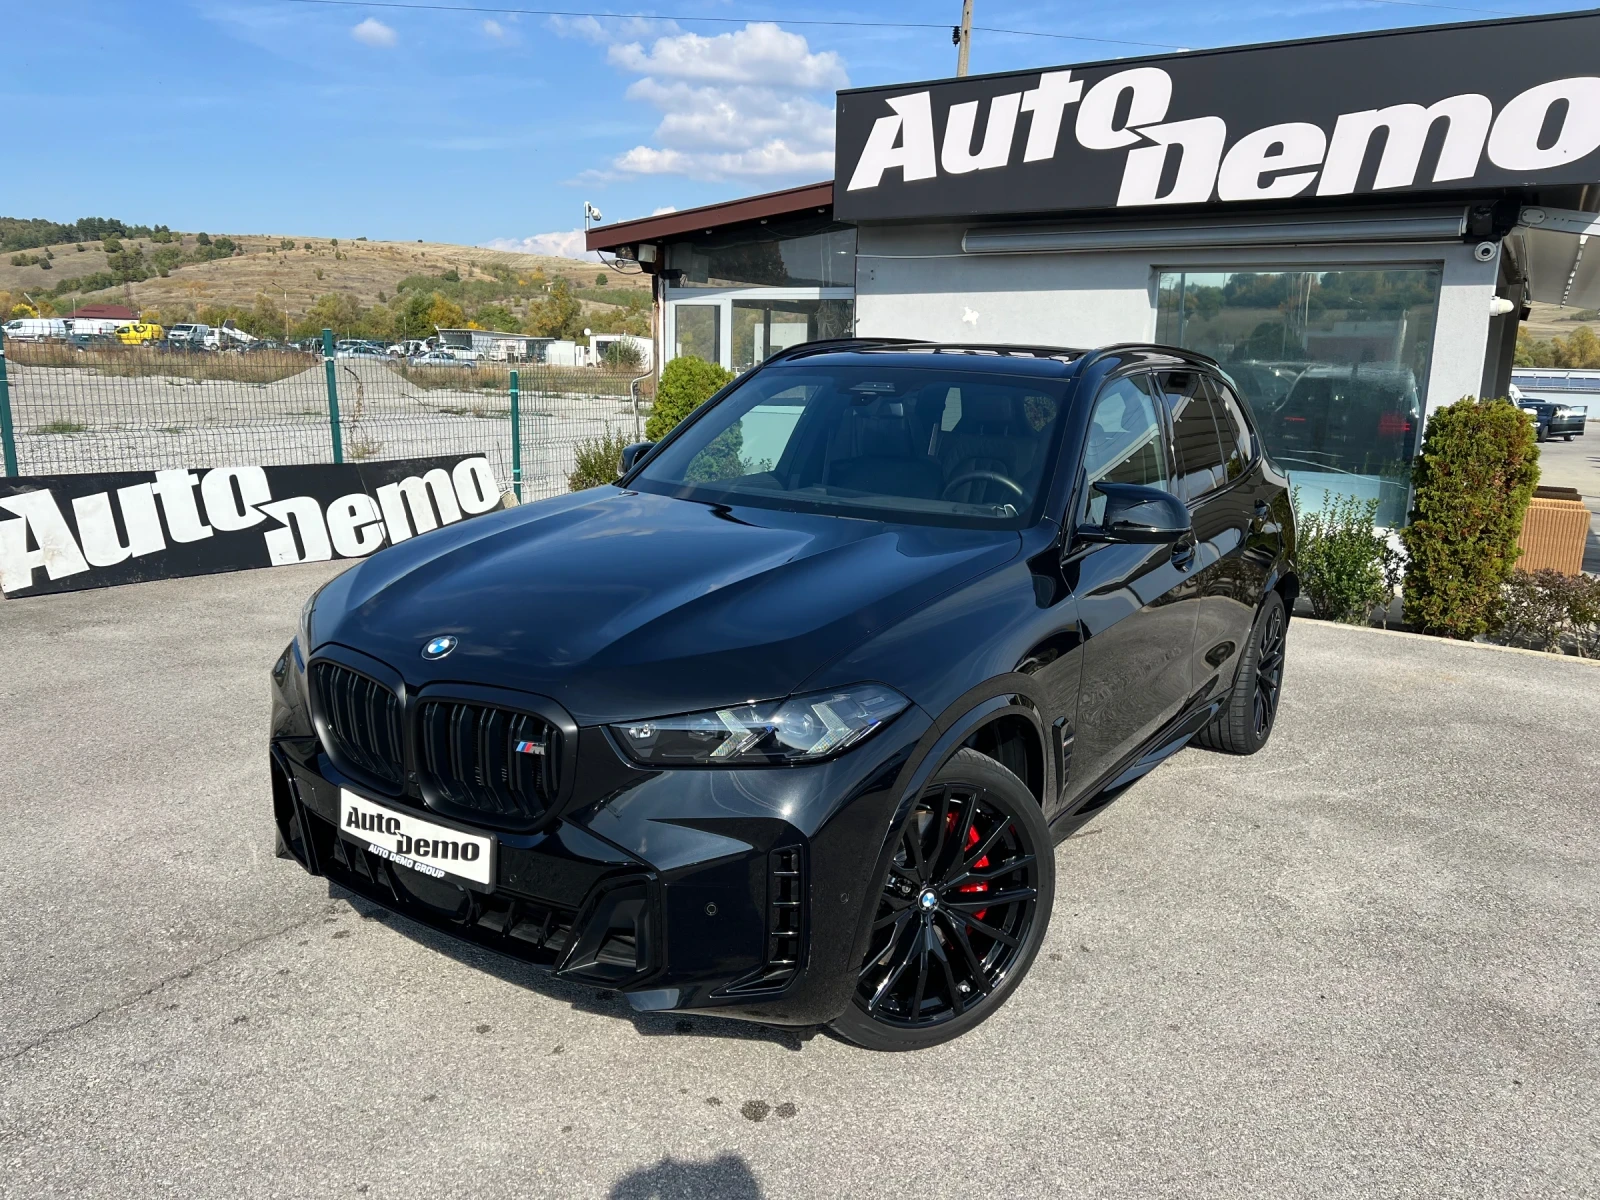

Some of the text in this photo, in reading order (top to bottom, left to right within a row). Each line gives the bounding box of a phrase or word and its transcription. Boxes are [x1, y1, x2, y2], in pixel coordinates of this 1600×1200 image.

[848, 66, 1172, 191] Auto
[1117, 76, 1600, 206] Demo
[0, 465, 271, 592] Auto
[258, 457, 500, 566] Demo
[346, 806, 401, 835] Auto
[368, 844, 445, 878] AUTO DEMO GROUP
[396, 834, 480, 861] Demo
